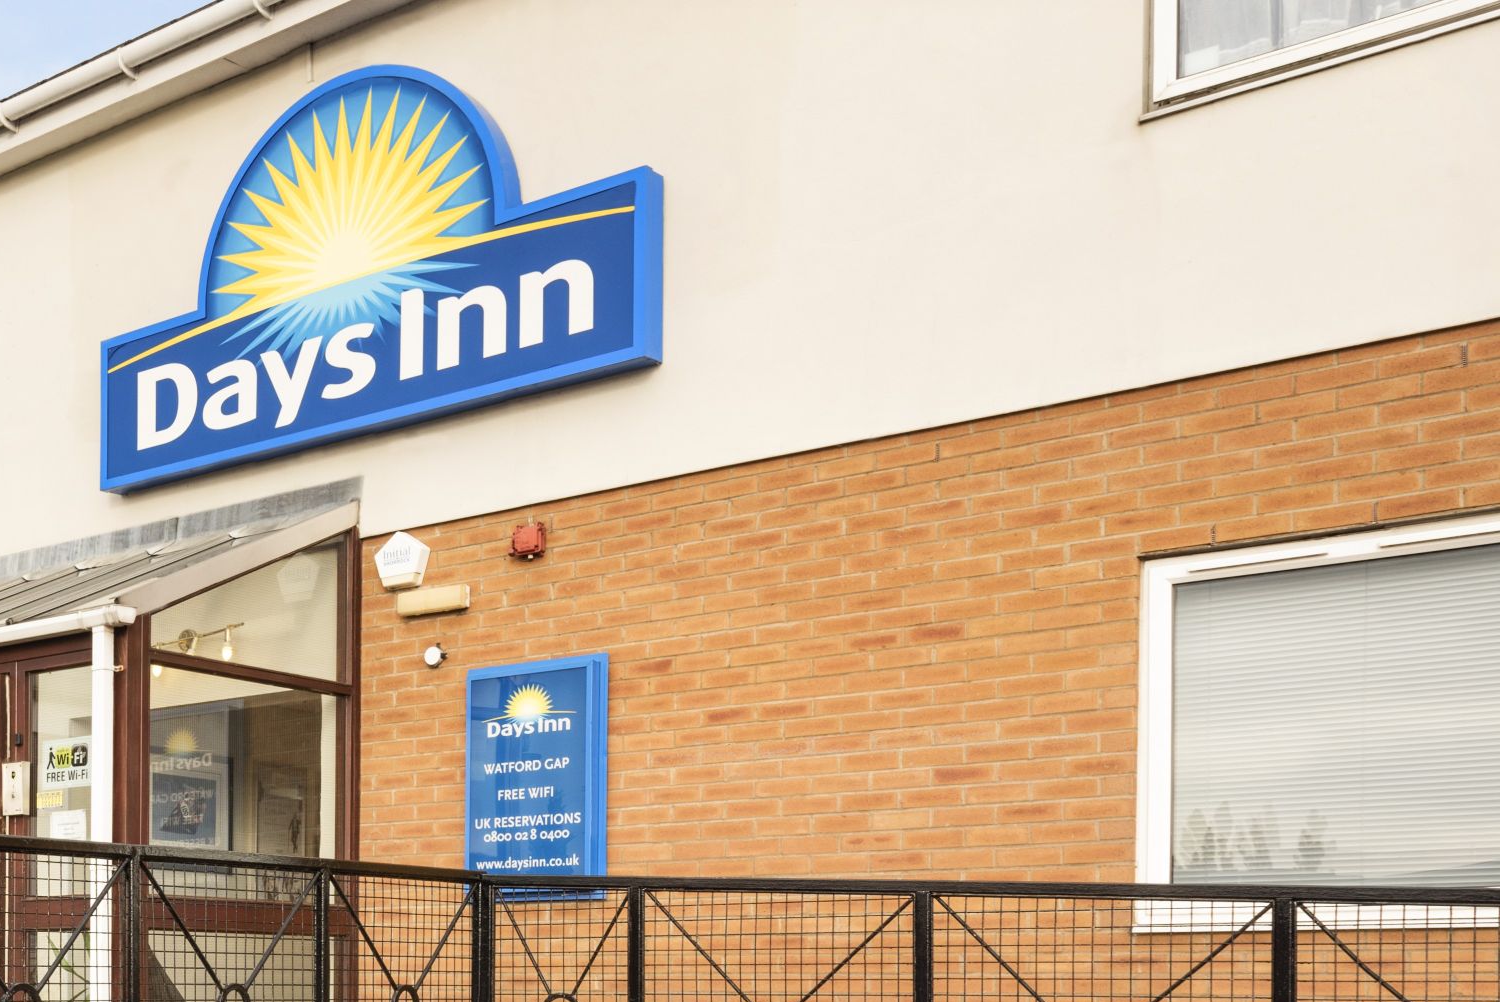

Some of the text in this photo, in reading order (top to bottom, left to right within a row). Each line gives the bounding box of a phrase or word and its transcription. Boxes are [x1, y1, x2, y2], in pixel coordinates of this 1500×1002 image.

[136, 259, 595, 451] Days Inn
[486, 717, 571, 738] Days Inn
[483, 757, 570, 775] WATFORD GAP
[46, 769, 89, 783] FREE Wi-Fi
[497, 786, 554, 801] FREE WIFI
[475, 812, 582, 830] UK RESERVATIONS
[483, 830, 512, 842] 0800
[539, 829, 570, 842] 0400
[476, 853, 580, 871] www.daysinn.co.uk
